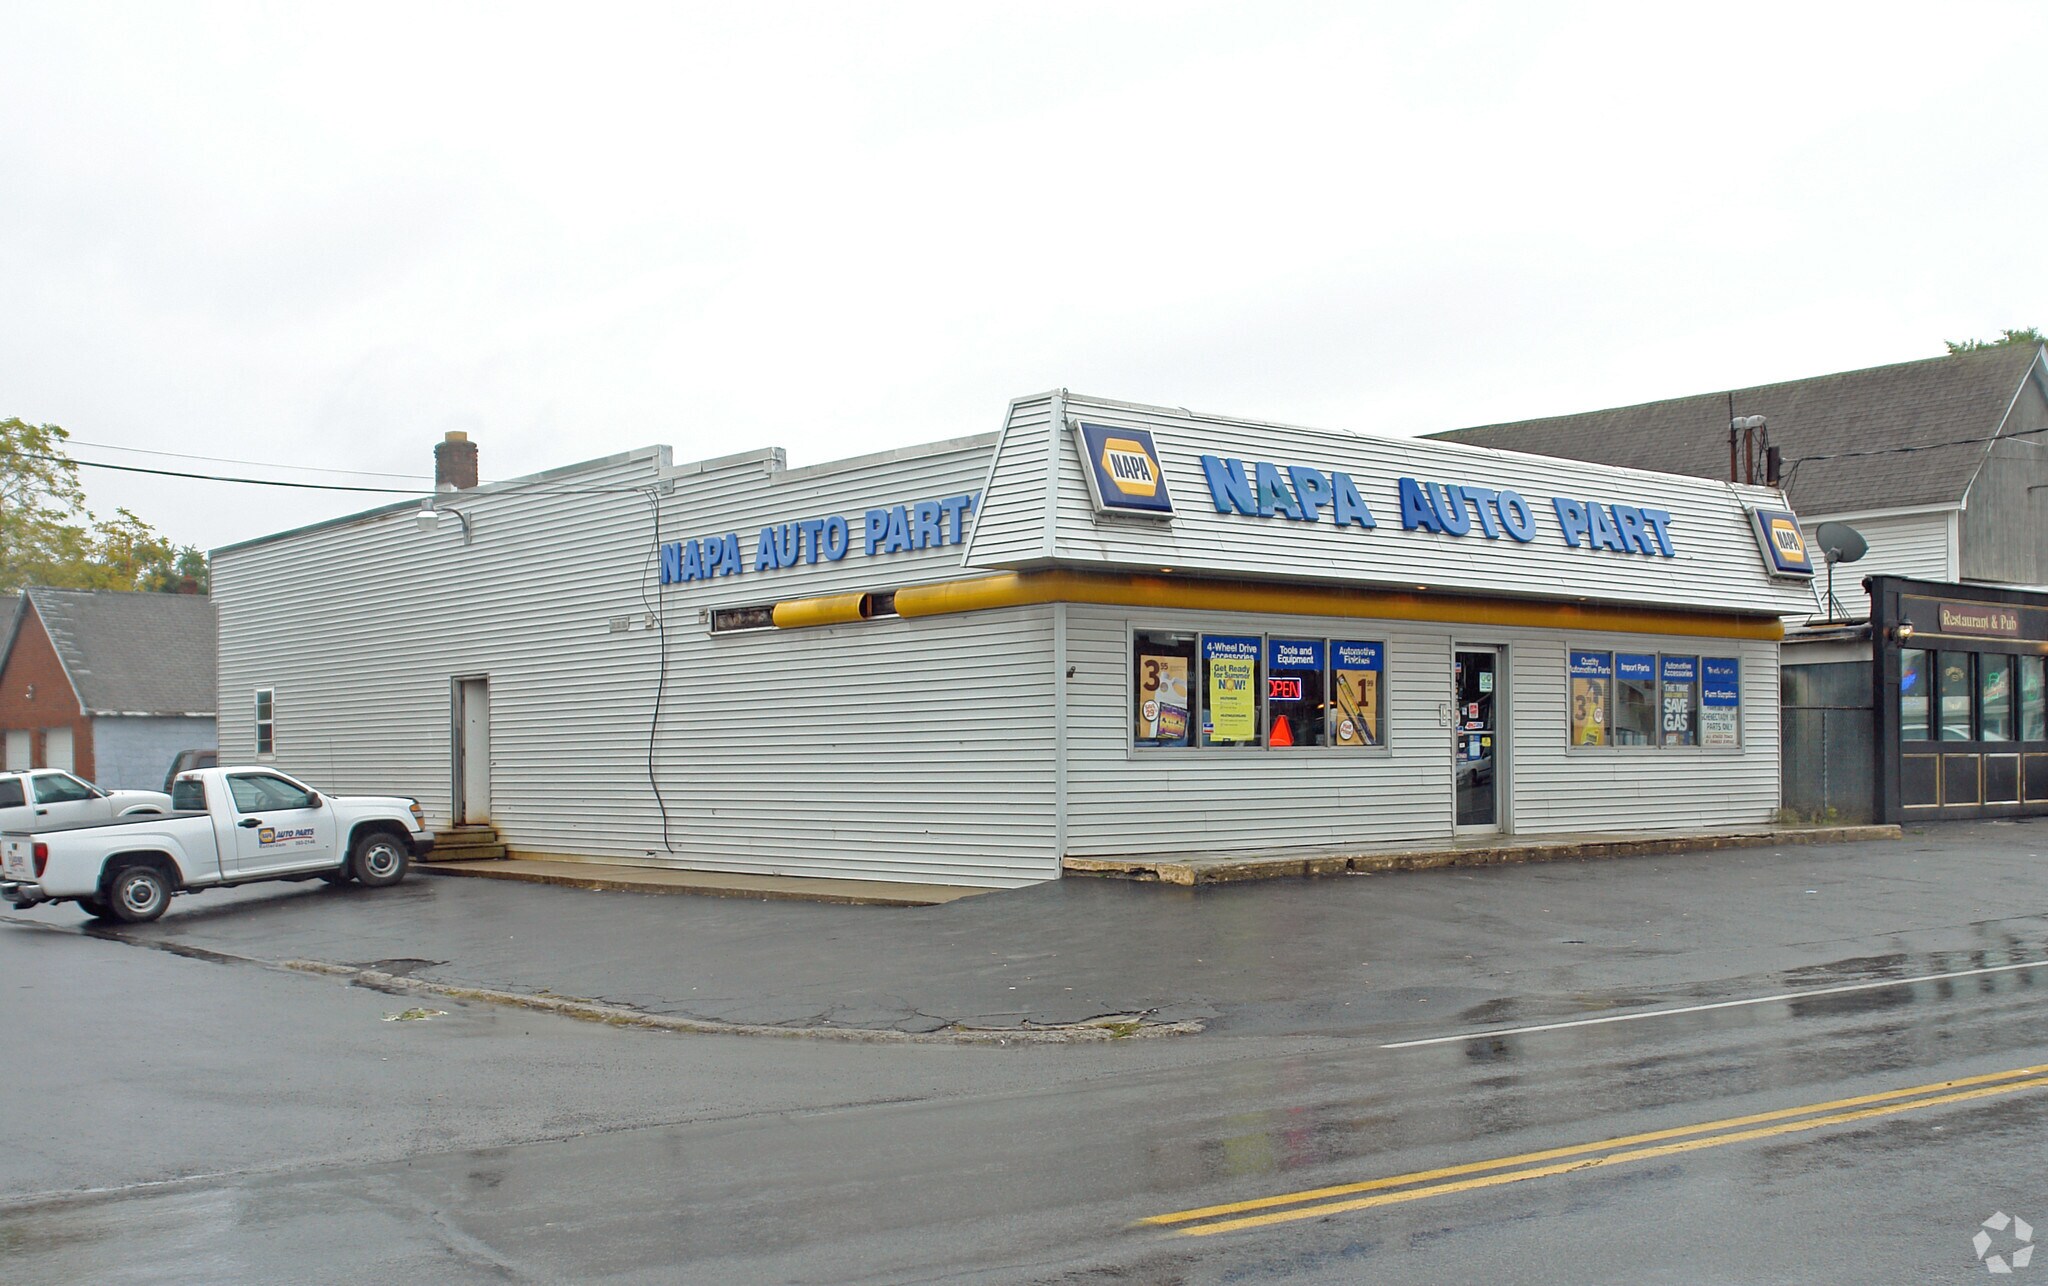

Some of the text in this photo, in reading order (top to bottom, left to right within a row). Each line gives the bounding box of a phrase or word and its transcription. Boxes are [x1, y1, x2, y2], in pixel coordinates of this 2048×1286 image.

[1110, 453, 1153, 482] NAPA
[1199, 454, 1676, 558] NAPA AUTO PART
[1776, 529, 1801, 552] NAPA
[660, 532, 743, 585] NAPA
[754, 515, 849, 571] AUTO
[1943, 609, 2017, 630] Restaurant & Pub
[1206, 642, 1258, 654] 4-Wheel Drive
[1280, 645, 1312, 655] Tools and
[1338, 646, 1376, 657] Automotive
[1277, 654, 1314, 666] Equipment
[1581, 657, 1599, 667] Quality
[1664, 661, 1692, 670] Automotive
[1214, 664, 1250, 674] Get Ready
[1621, 663, 1650, 672] Import Parts
[1143, 659, 1160, 691] 3
[1358, 678, 1369, 707] 1
[1664, 698, 1688, 714] SAVE
[1663, 713, 1688, 731] GAS
[276, 828, 315, 838] AUTO PARTS
